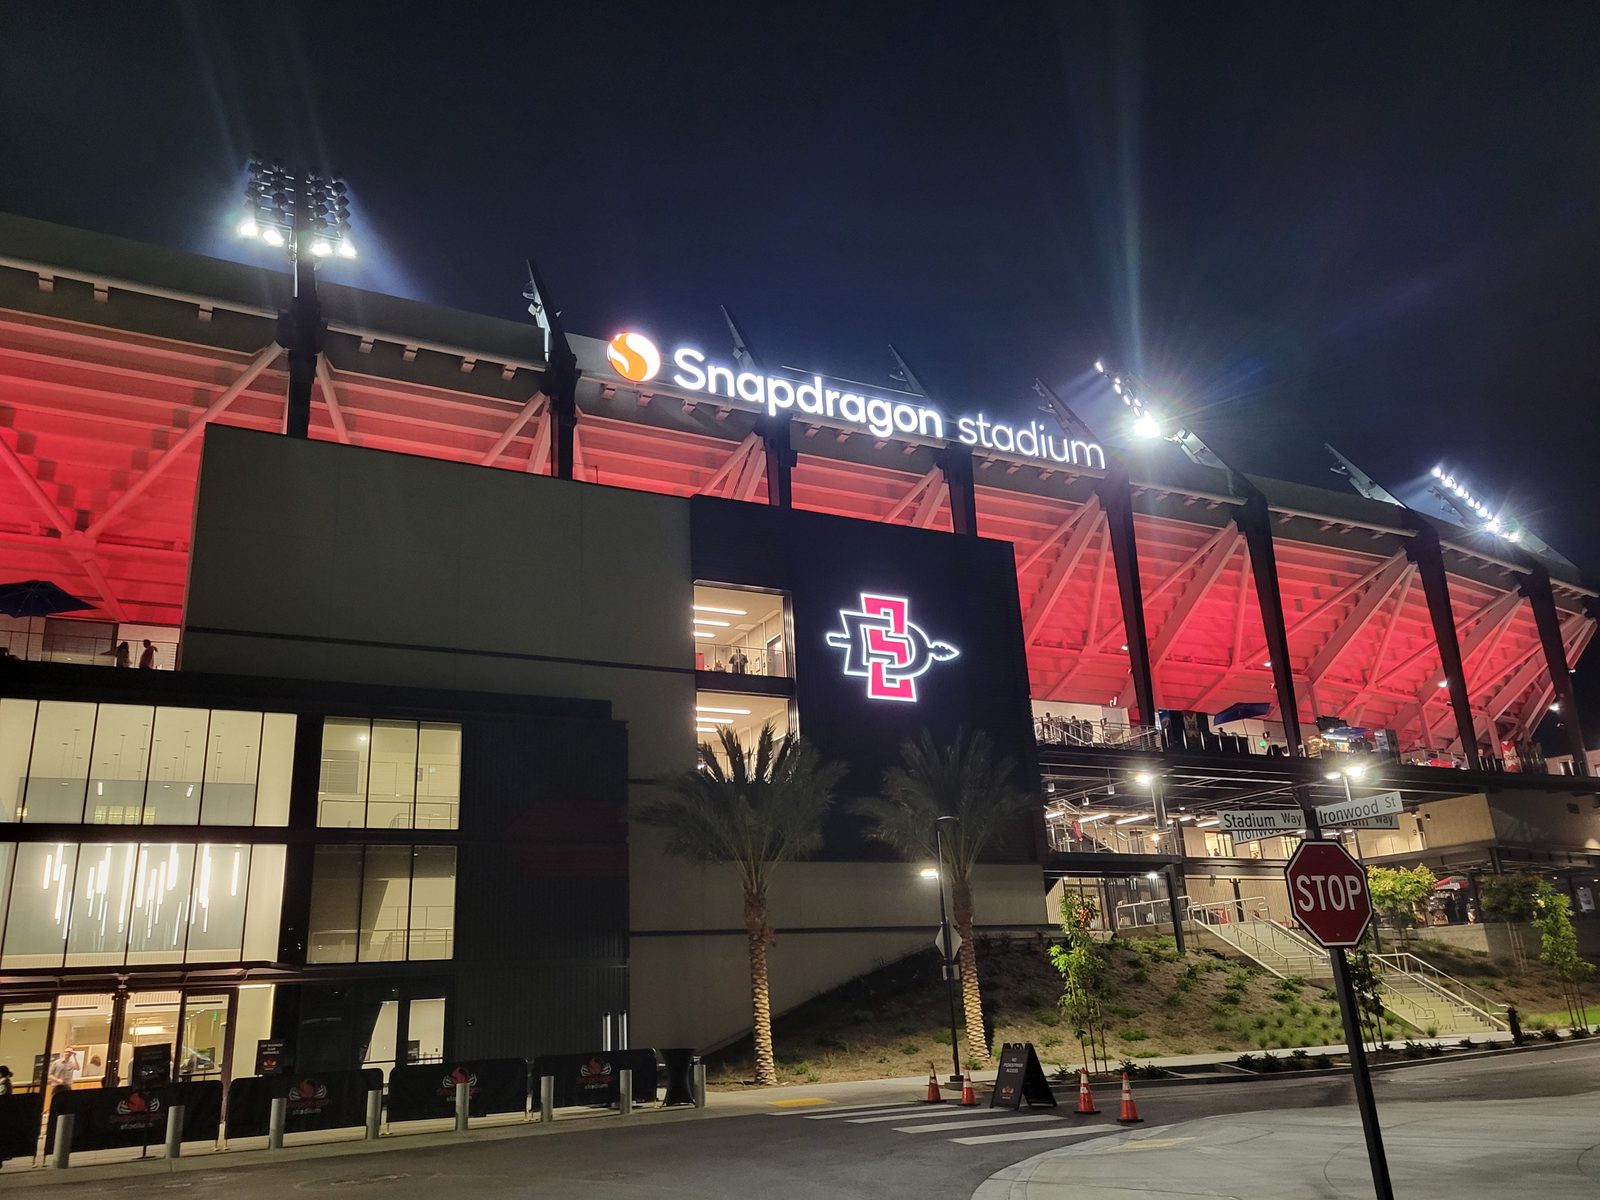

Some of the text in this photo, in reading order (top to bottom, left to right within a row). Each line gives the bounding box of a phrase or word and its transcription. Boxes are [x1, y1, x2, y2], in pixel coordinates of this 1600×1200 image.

[672, 348, 1106, 469] Snapdragon stadium
[1223, 812, 1301, 828] Stadium Way
[1319, 799, 1379, 825] Ironwood
[1384, 796, 1396, 808] St
[1296, 874, 1362, 912] STOP
